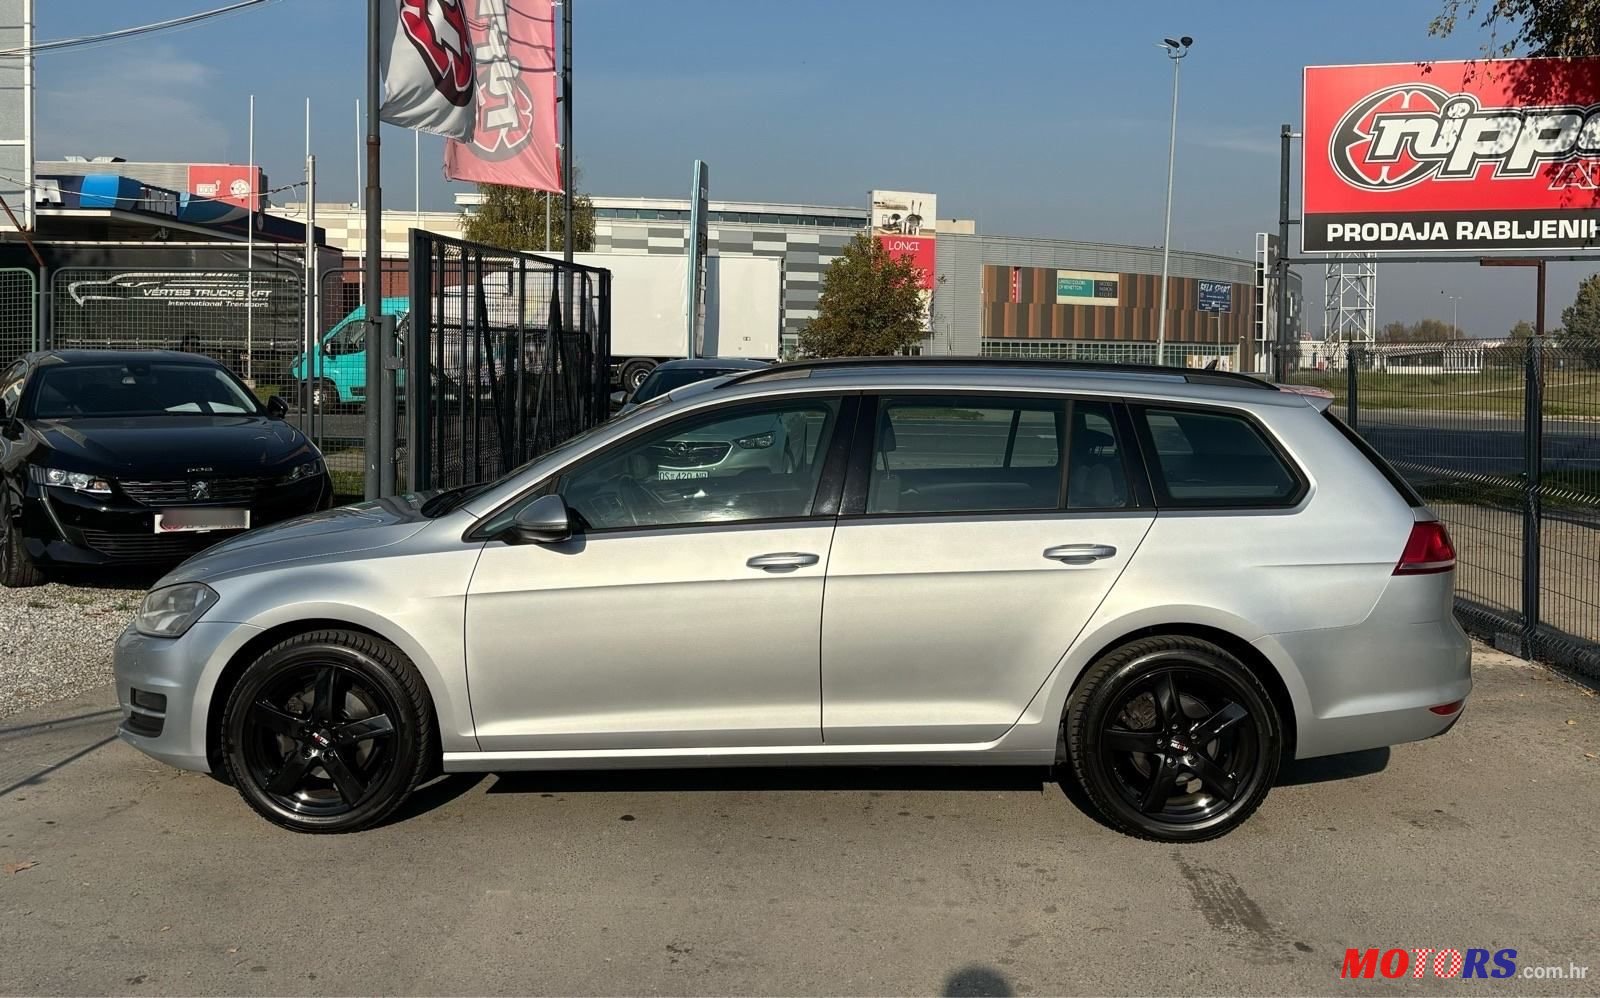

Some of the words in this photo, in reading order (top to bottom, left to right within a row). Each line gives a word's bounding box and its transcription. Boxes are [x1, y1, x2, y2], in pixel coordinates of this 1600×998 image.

[1327, 221, 1449, 242] PRODAJA
[888, 240, 920, 251] LONCI
[194, 289, 245, 297] TRUCKS
